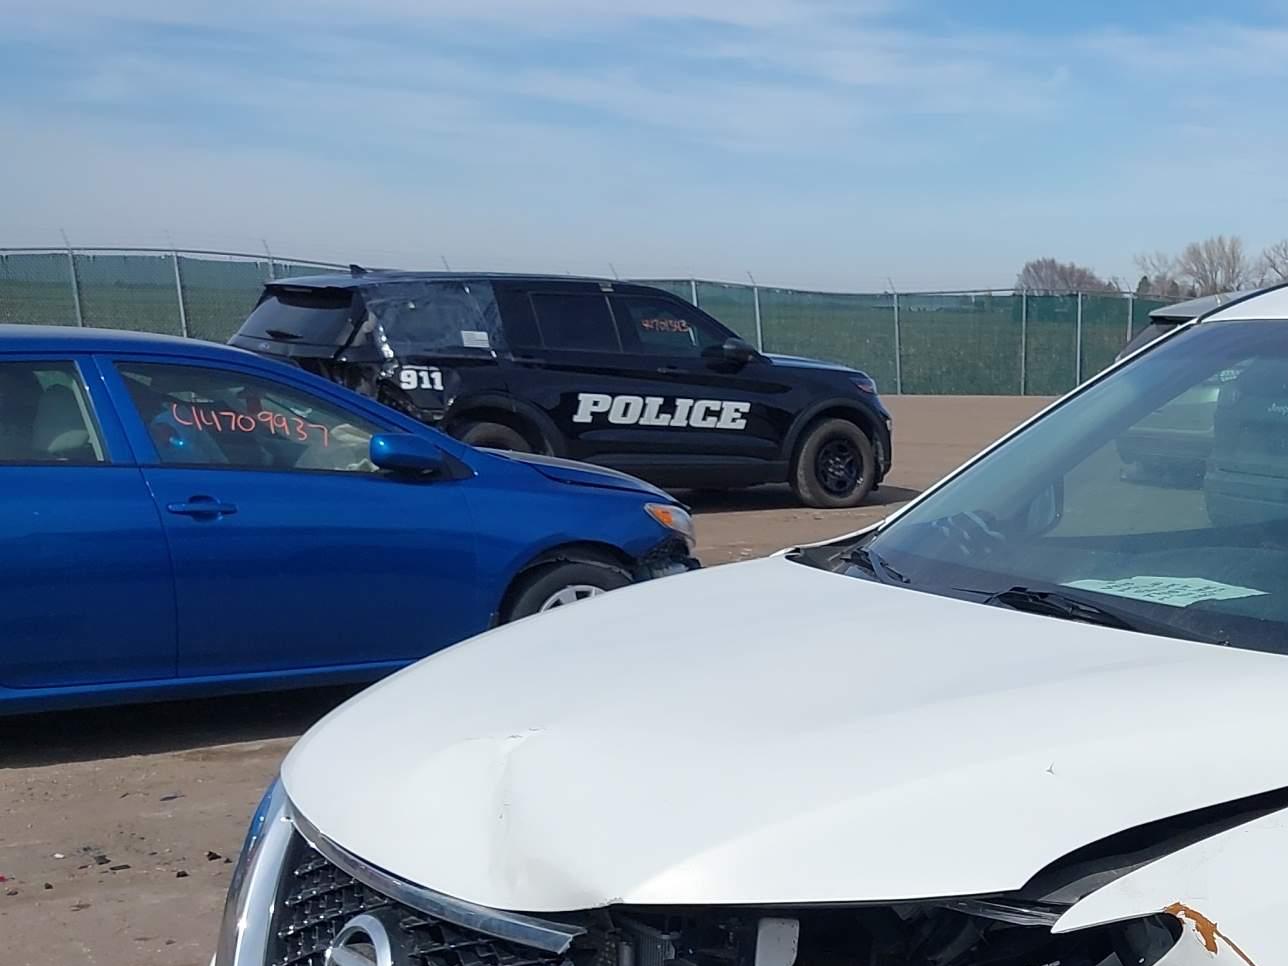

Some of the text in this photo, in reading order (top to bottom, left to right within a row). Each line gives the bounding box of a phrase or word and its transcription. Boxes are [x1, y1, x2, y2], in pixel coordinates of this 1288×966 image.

[400, 370, 444, 391] 911
[172, 403, 329, 448] 44709937
[572, 393, 751, 430] POLICE
